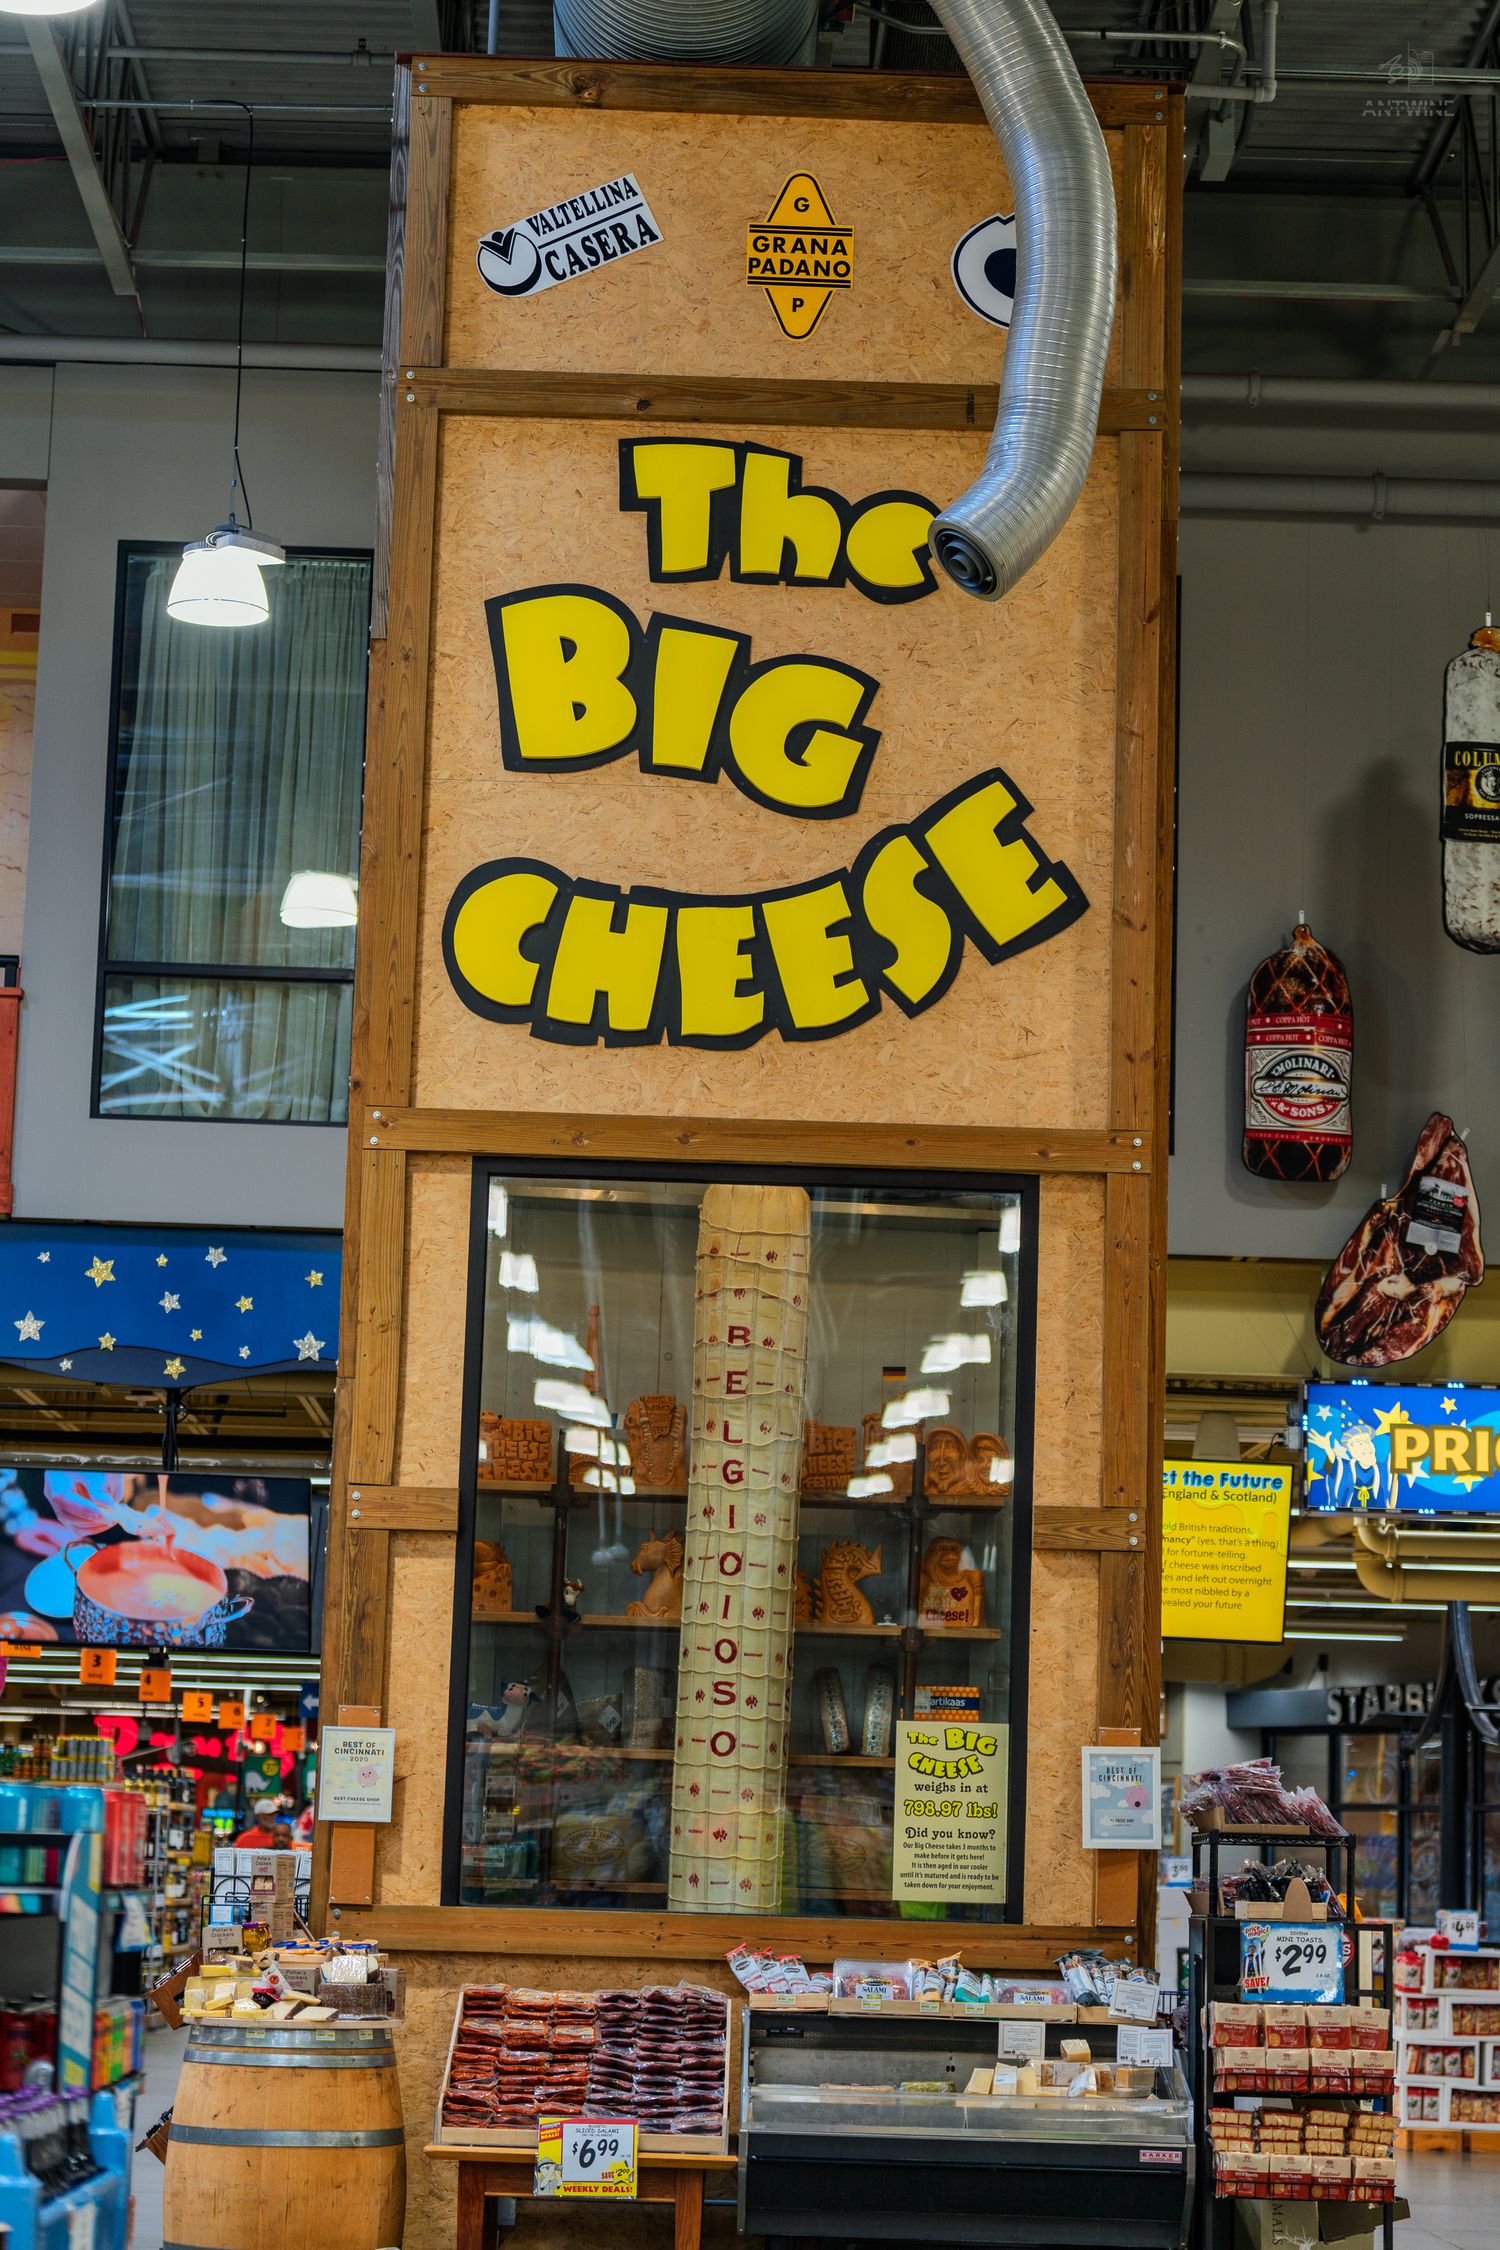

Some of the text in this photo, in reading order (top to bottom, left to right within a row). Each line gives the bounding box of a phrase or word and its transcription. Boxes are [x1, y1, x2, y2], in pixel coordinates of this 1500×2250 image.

[526, 177, 638, 237] VALTELLINA
[794, 197, 810, 212] G
[545, 213, 659, 281] CASERA
[752, 235, 848, 256] GRANA
[748, 257, 851, 278] PADANO
[791, 297, 805, 312] P
[484, 583, 881, 820] BIG
[442, 768, 1090, 1050] CHEESE
[1274, 1057, 1333, 1078] MOLINARI
[1290, 1104, 1326, 1117] SONS
[493, 1440, 551, 1460] HEESE
[1390, 1423, 1500, 1477] PRI
[807, 1455, 856, 1473] HEESE
[803, 1474, 849, 1489] FESTIVA
[1183, 1470, 1284, 1491] the Future
[1210, 1490, 1219, 1500] &
[1223, 1490, 1277, 1504] Scotland)
[1179, 1523, 1207, 1532] British
[1219, 1538, 1243, 1547] that's
[1252, 1540, 1279, 1551] thing)
[1167, 1548, 1179, 1556] for
[1169, 1561, 1200, 1570] cheese
[1221, 1563, 1262, 1573] inscribed
[1176, 1574, 1272, 1588] and left out overnight
[1171, 1587, 1193, 1595] most
[1195, 1587, 1230, 1597] nibbled
[1231, 1589, 1243, 1599] by
[1193, 1600, 1213, 1610] your
[1215, 1600, 1243, 1610] future
[925, 1609, 969, 1622] Cheese!
[92, 1654, 102, 1668] 3
[145, 1673, 152, 1685] 4
[198, 1698, 205, 1708] 5
[930, 1697, 966, 1707] artikaas
[907, 1727, 998, 1756] The BIG
[334, 1748, 385, 1756] CINCINNATI
[908, 1752, 984, 1779] CHEESE
[914, 1781, 988, 1794] weighs in at
[903, 1799, 998, 1819] 798.97 lbs!
[905, 1827, 996, 1840] Did you know?
[914, 1842, 924, 1851] Big
[925, 1842, 945, 1850] Cheese
[967, 1843, 988, 1851] months
[956, 1853, 968, 1861] gets
[938, 1863, 953, 1871] aged
[961, 1883, 995, 1892] enjoyment.
[1245, 1977, 1270, 1988] SAVE!
